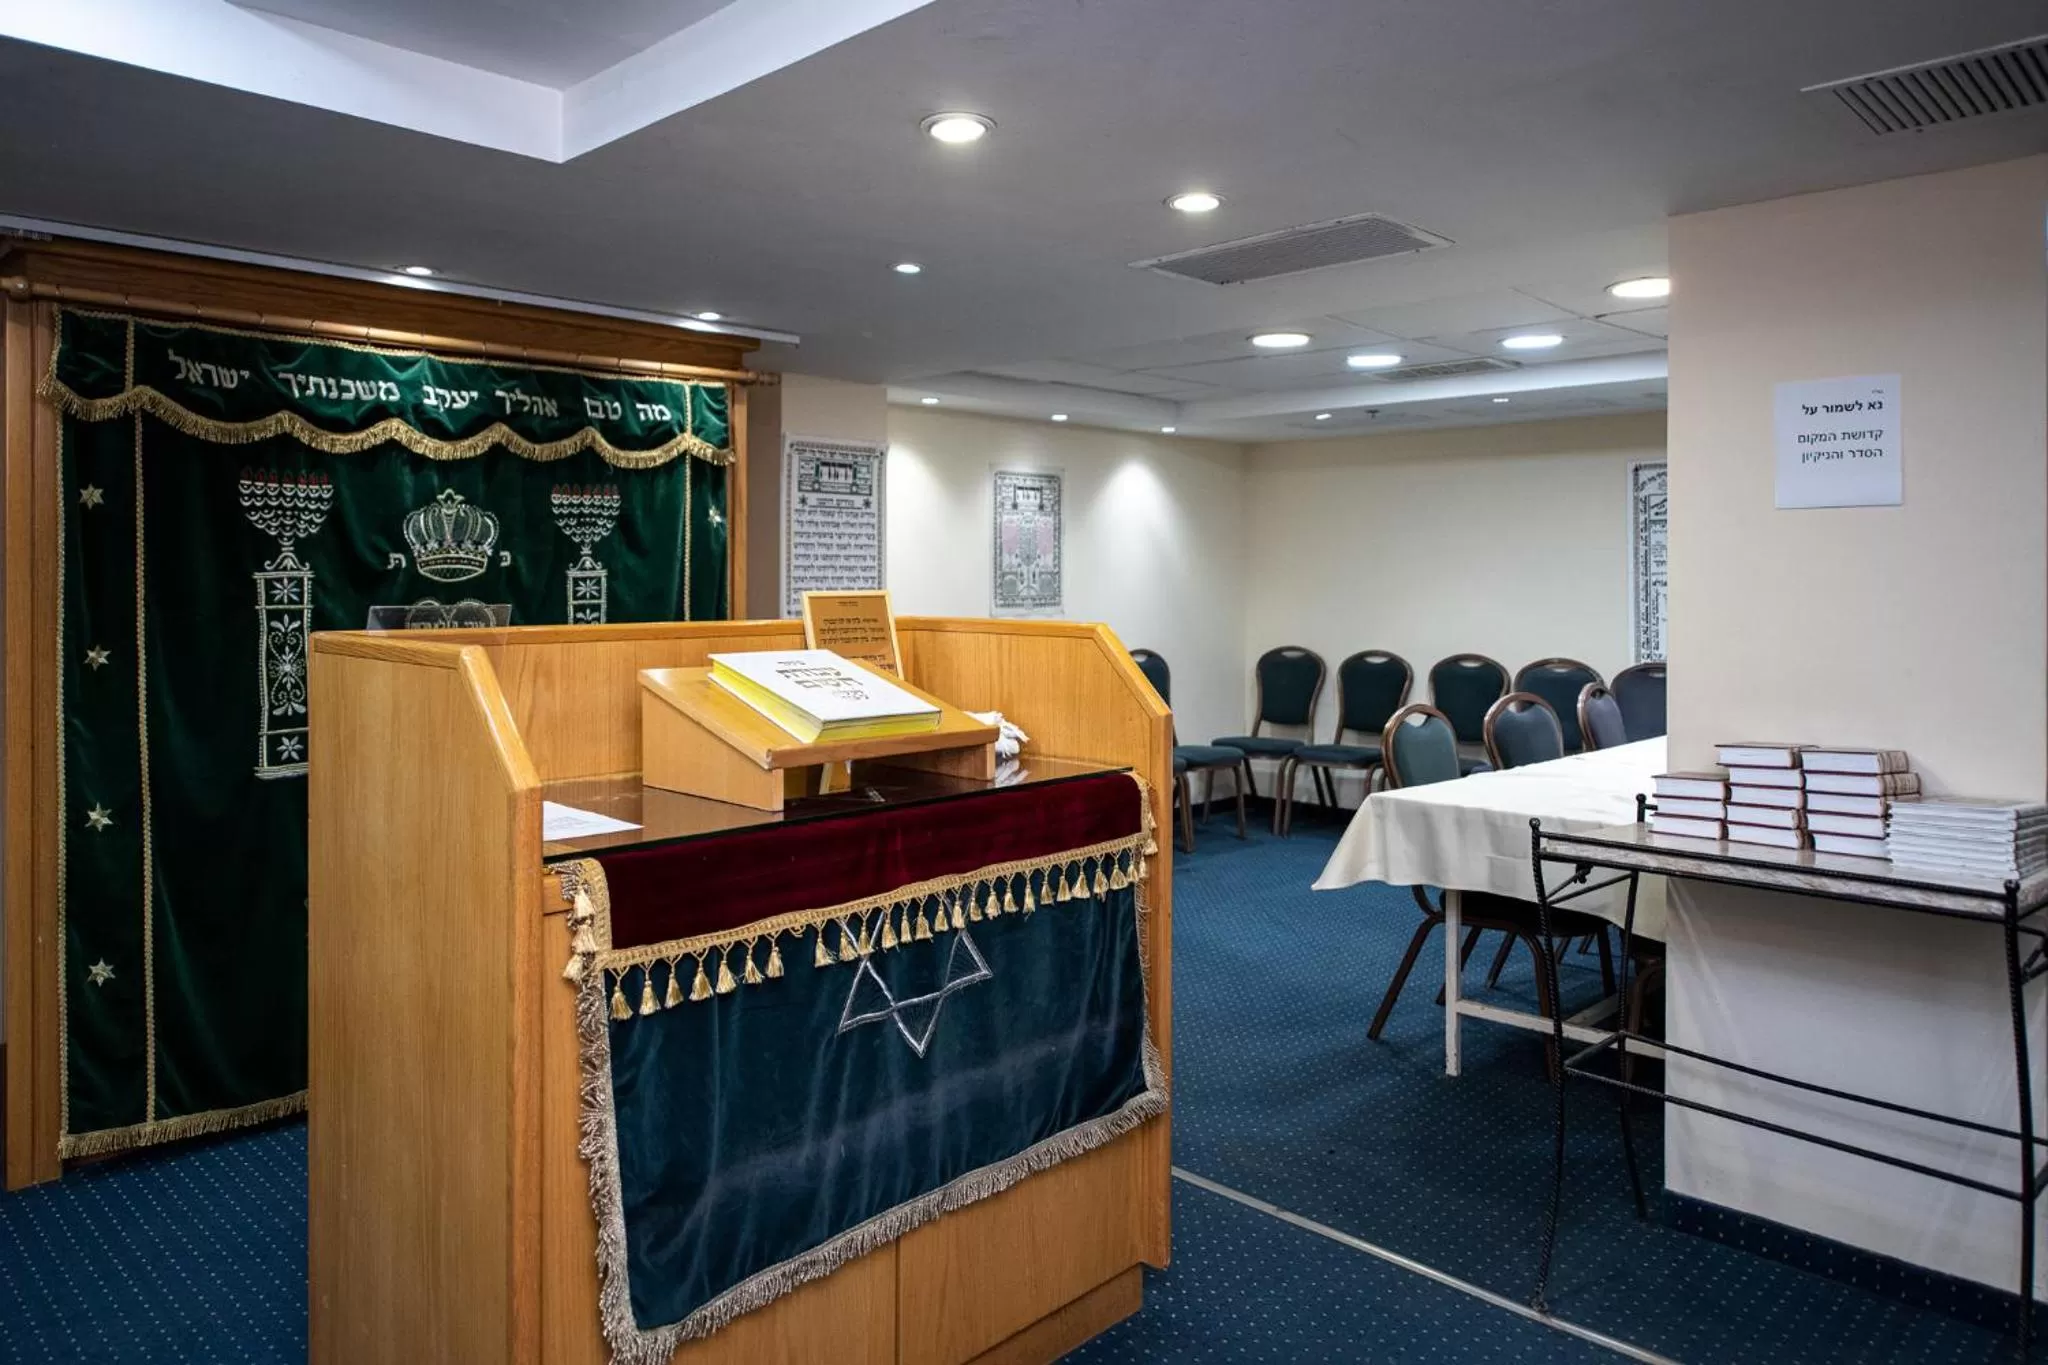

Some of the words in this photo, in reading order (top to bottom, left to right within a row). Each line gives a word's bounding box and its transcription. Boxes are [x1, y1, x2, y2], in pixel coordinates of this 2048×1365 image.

[168, 348, 250, 389] ישראל
[277, 372, 402, 402] משכנתיך
[422, 384, 479, 413] יעקב
[495, 387, 560, 418] אהליך
[1822, 399, 1864, 414] לשמור
[1867, 400, 1884, 411] נא
[583, 397, 622, 420] טבו
[636, 401, 673, 421] מה
[1802, 404, 1818, 416] על
[1797, 432, 1837, 446] המקום
[1841, 429, 1884, 442] קדושת
[1848, 448, 1883, 459] הסדר
